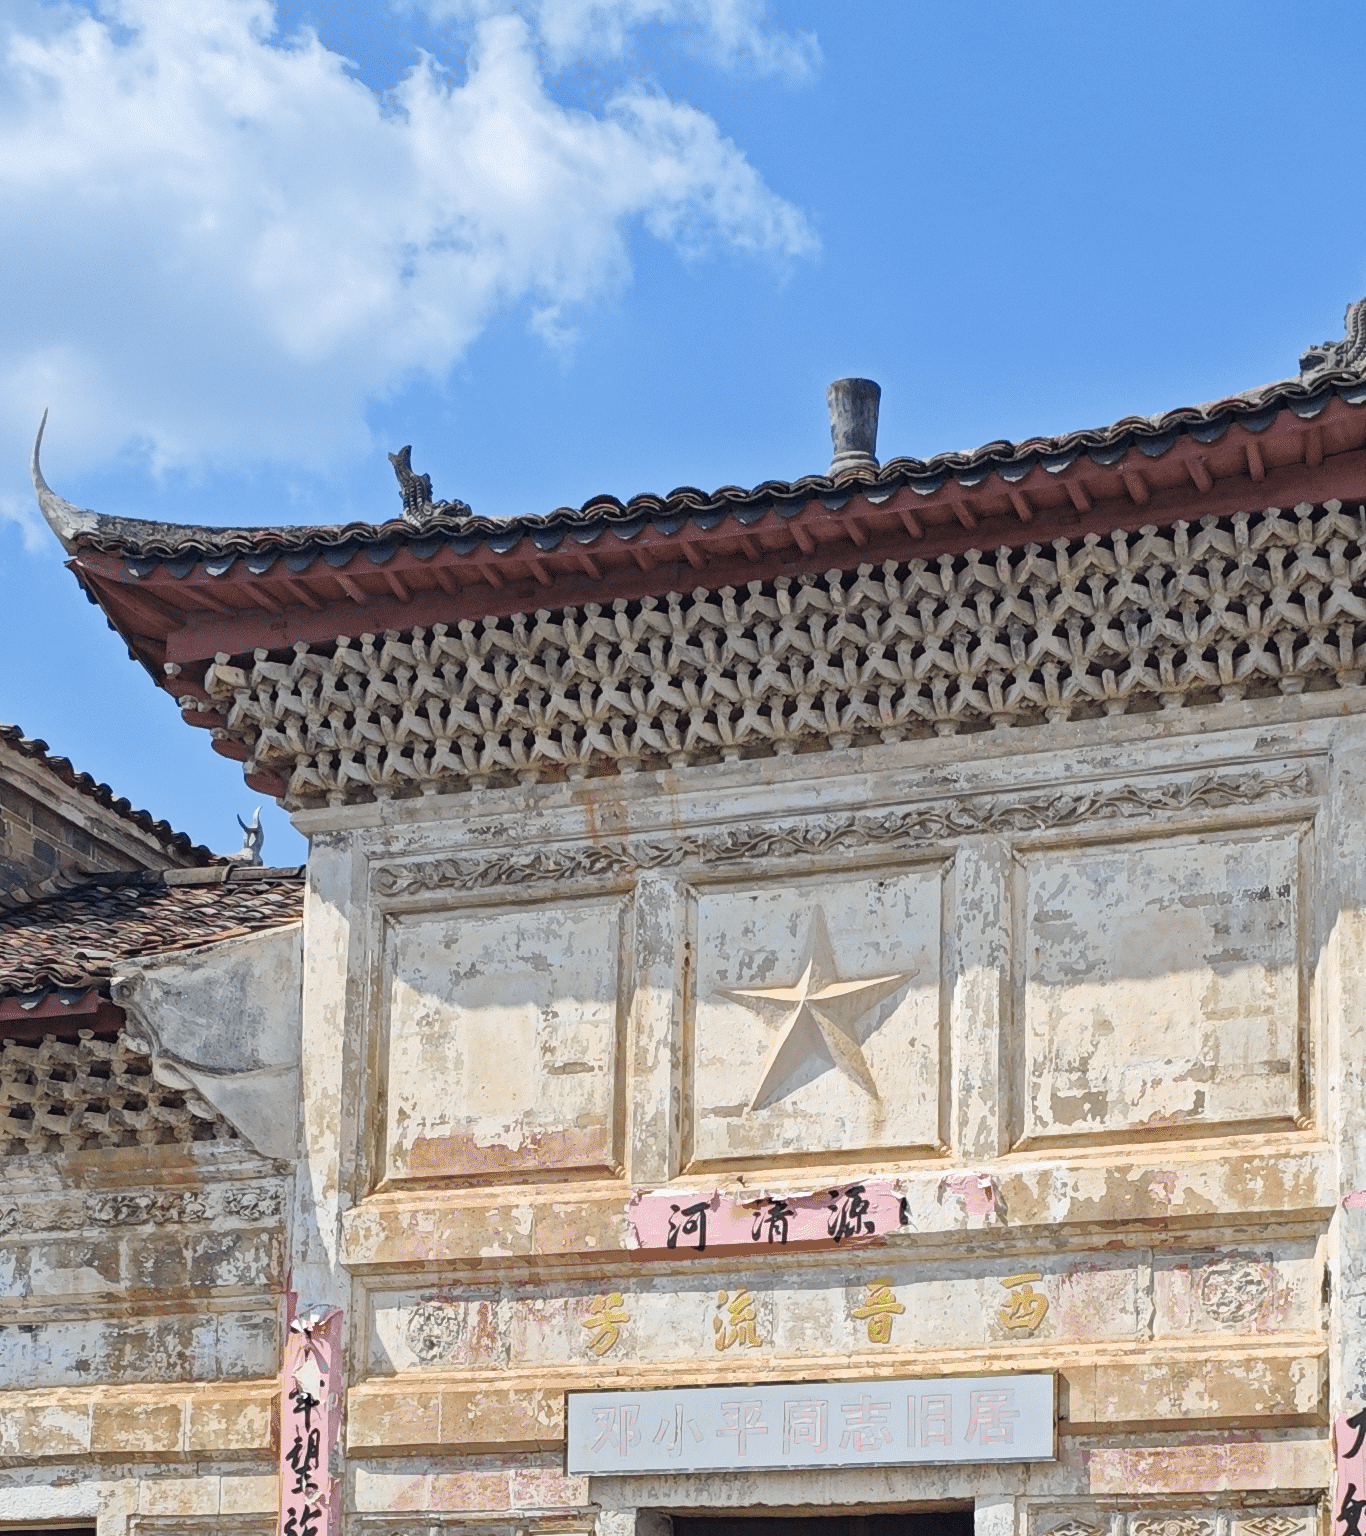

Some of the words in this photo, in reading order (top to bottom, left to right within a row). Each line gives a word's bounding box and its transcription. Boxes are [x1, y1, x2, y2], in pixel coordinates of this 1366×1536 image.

[591, 1388, 1020, 1457] 邓小平同志旧居
